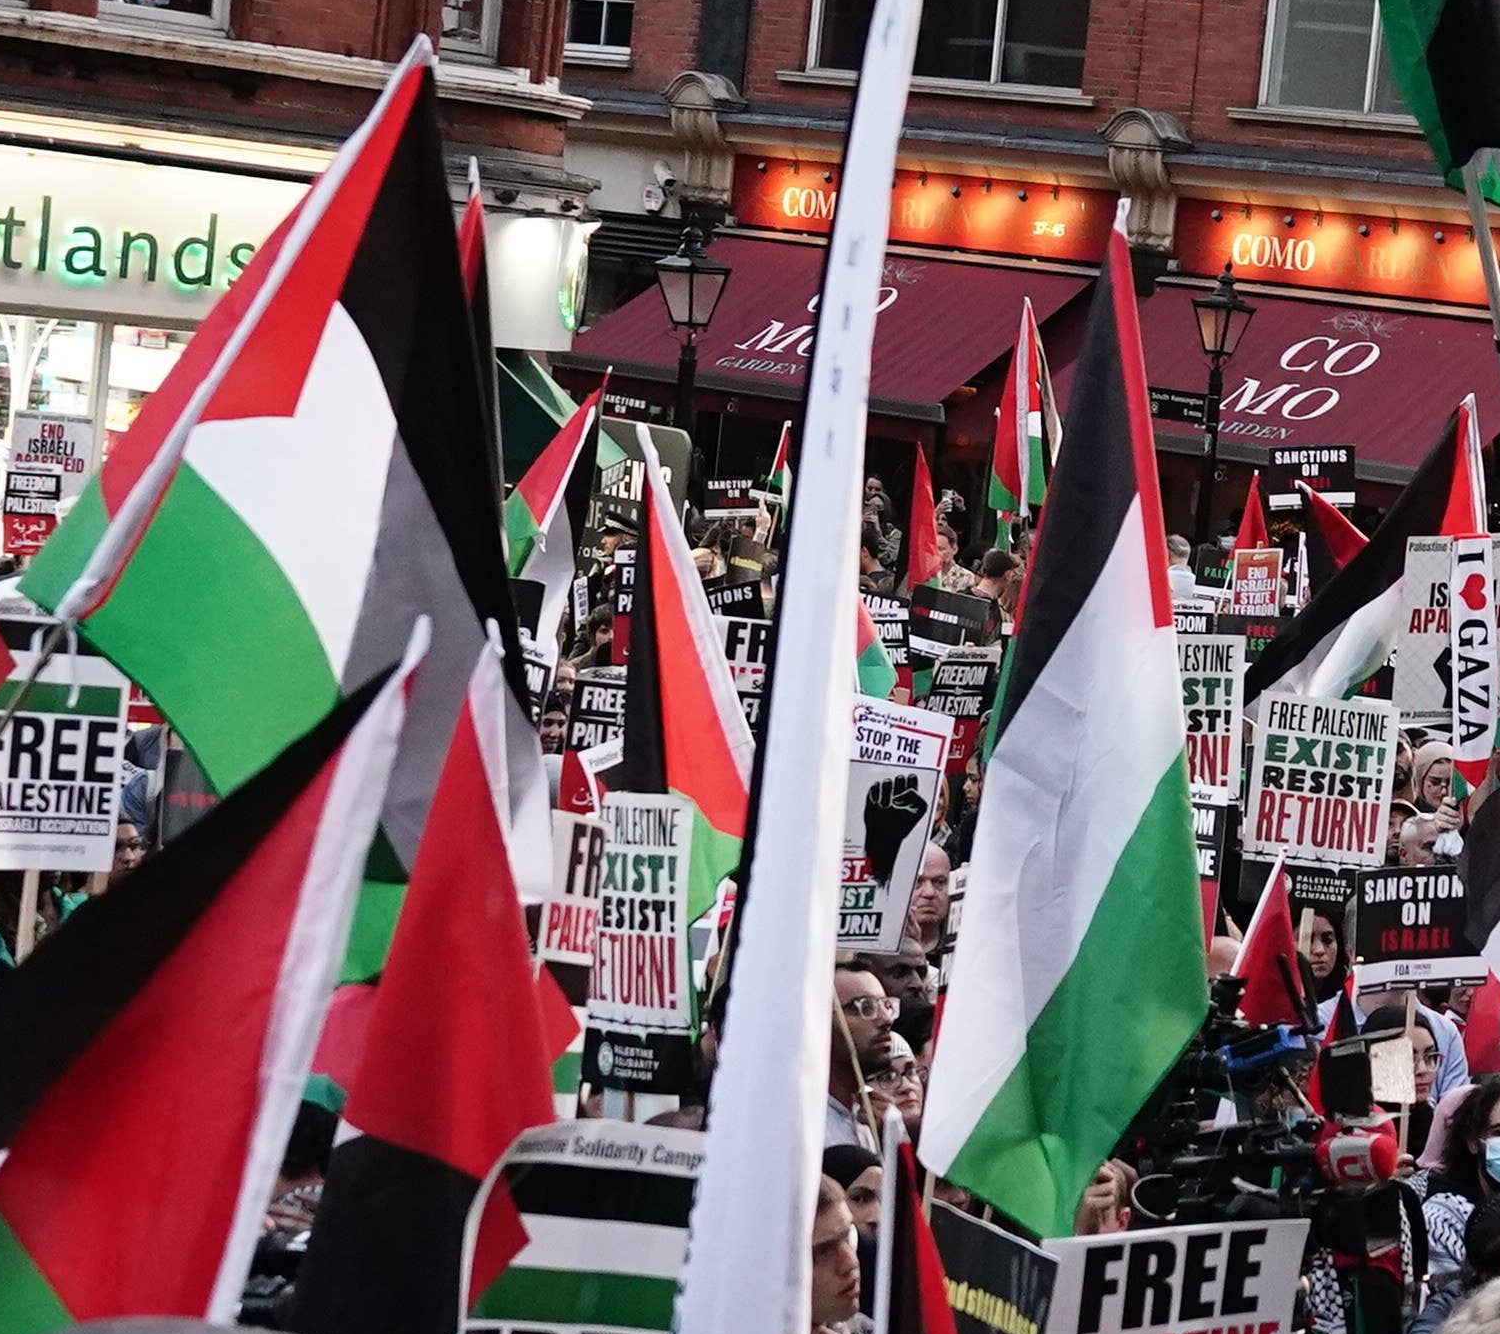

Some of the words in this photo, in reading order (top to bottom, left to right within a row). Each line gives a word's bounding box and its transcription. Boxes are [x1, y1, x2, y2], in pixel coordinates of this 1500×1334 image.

[783, 187, 838, 221] COM
[1232, 232, 1316, 271] COMO
[1280, 336, 1380, 377] CO
[1220, 377, 1340, 418] MO
[41, 424, 65, 439] END
[28, 440, 75, 456] ISRAELI
[1274, 449, 1348, 464] SANCTIONS
[1301, 463, 1321, 477] ON
[9, 474, 57, 490] FREEDOM
[1236, 578, 1275, 593] ISRAELI
[1239, 591, 1271, 604] STATE
[935, 666, 987, 686] FREEDOM
[1456, 619, 1489, 747] GAZA
[928, 695, 982, 717] PALESTINE
[1268, 701, 1307, 731] FREE
[1311, 704, 1389, 743] PALESTINE
[897, 732, 921, 754] THE
[1266, 733, 1387, 775] EXIST!
[1262, 766, 1384, 801] RESIST!
[1256, 790, 1380, 854] RETURN!
[1295, 883, 1351, 895] SOLIDARITY
[1296, 874, 1347, 888] PALESTINE
[1295, 890, 1344, 902] CAMPAIGN
[1400, 902, 1433, 926] ON
[573, 1137, 647, 1164] Solidarity
